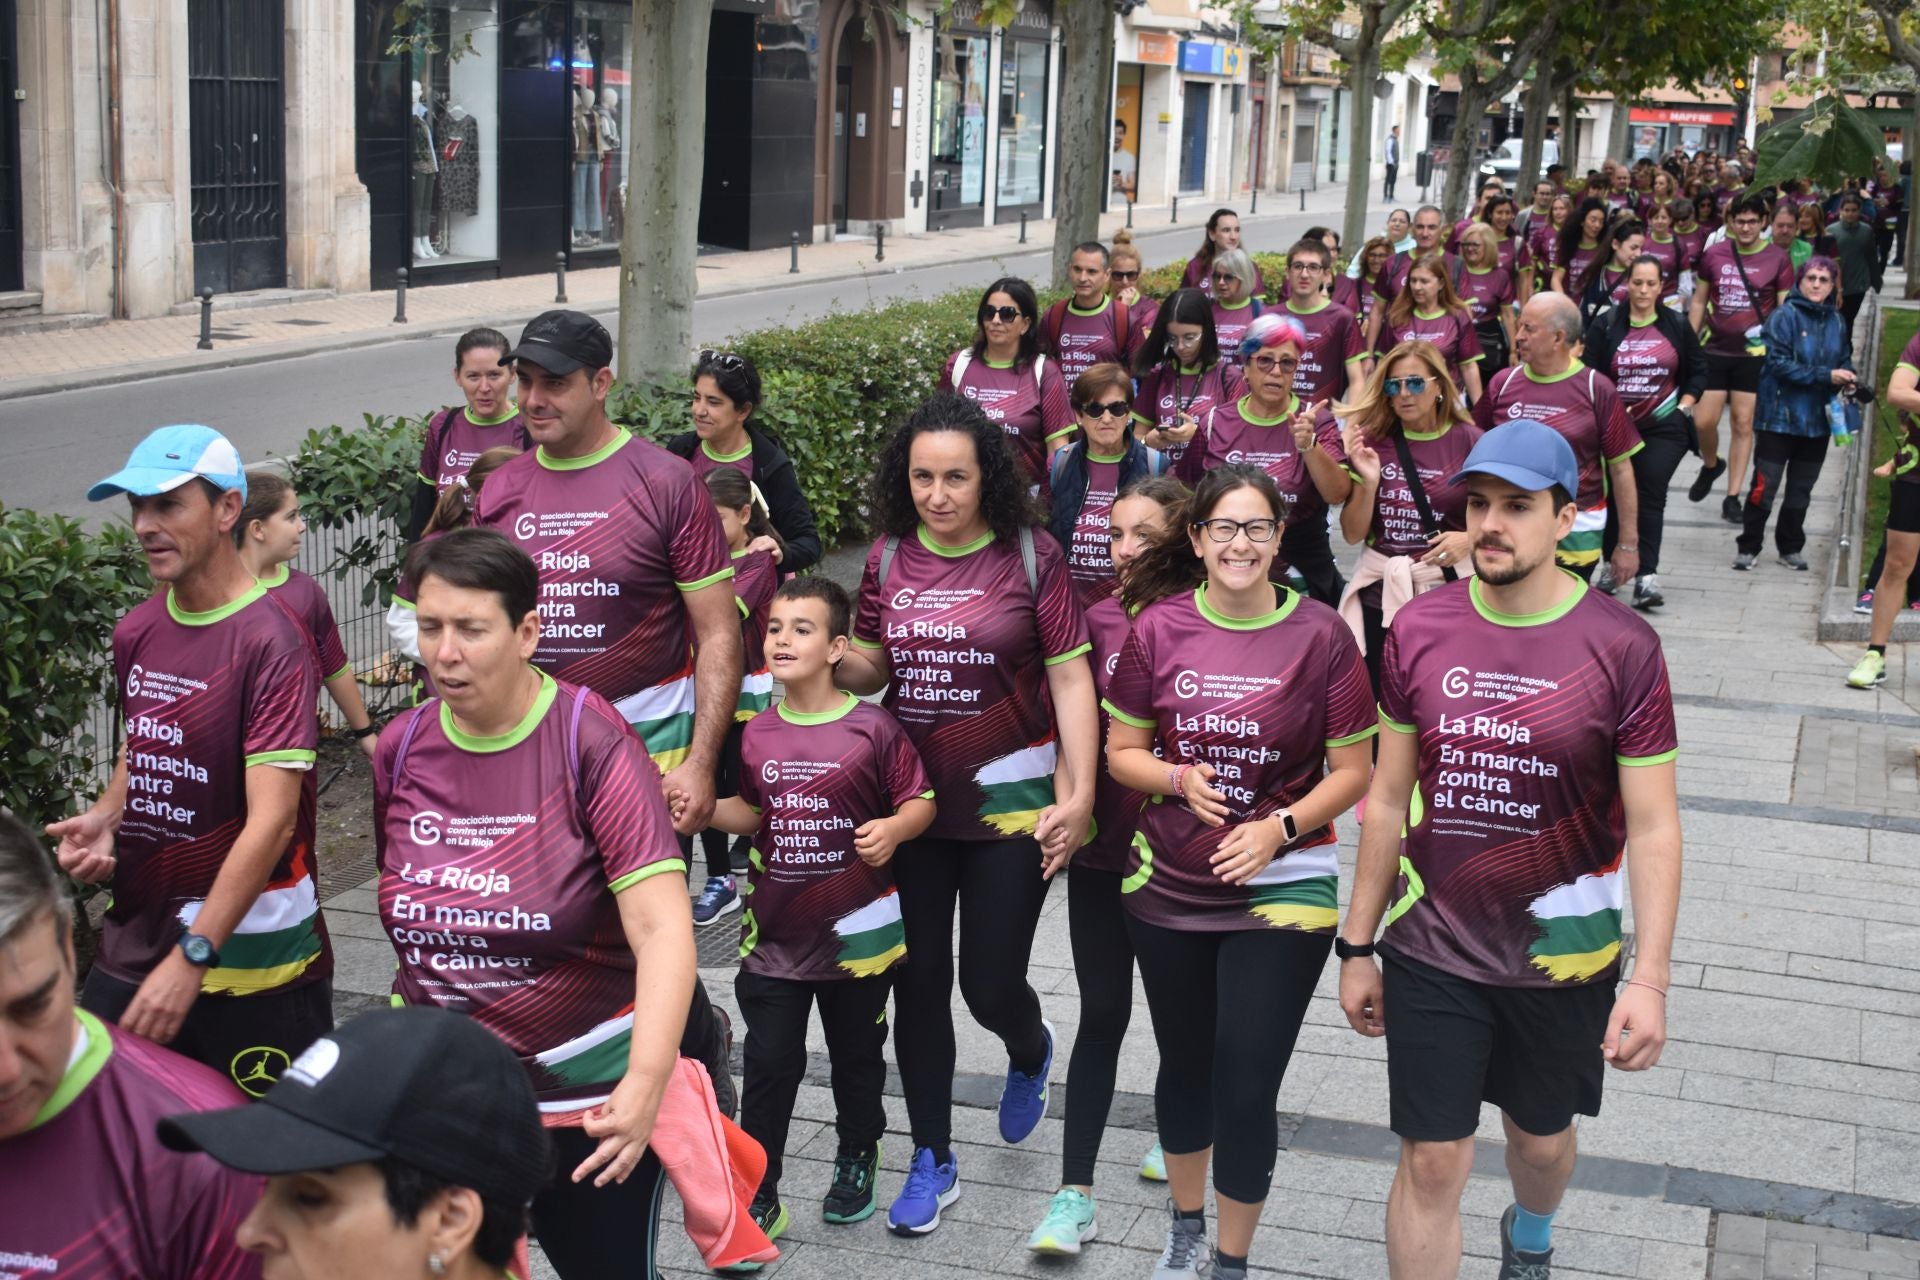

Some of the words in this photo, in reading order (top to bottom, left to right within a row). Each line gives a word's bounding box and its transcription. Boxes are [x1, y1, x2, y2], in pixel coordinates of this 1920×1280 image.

[1670, 112, 1712, 122] MAPFRE
[1061, 352, 1070, 360] La
[1073, 352, 1095, 361] Rioja
[1618, 356, 1630, 364] La
[1632, 355, 1657, 365] Rioja
[1632, 367, 1669, 375] marcha
[1161, 415, 1172, 424] La
[439, 473, 452, 484] La
[1379, 487, 1395, 499] La
[541, 512, 575, 520] asociación
[1380, 504, 1394, 515] En
[1086, 515, 1110, 528] Rioj
[1384, 519, 1419, 530] ontra
[559, 529, 575, 537] Rioja
[1072, 544, 1106, 554] ontra
[542, 550, 590, 572] Rioja
[543, 578, 619, 596] marcha
[537, 601, 575, 617] ntra
[538, 621, 605, 638] cáncer
[887, 623, 908, 638] La
[914, 621, 966, 642] Rioja
[891, 647, 913, 663] En
[917, 649, 995, 664] marcha
[146, 671, 177, 683] asociación
[179, 677, 208, 690] española
[896, 666, 952, 682] contra
[1204, 674, 1244, 683] asociación
[1246, 677, 1281, 685] española
[1476, 672, 1518, 682] asociación
[1520, 676, 1558, 689] española
[143, 680, 162, 690] contra
[163, 684, 171, 692] el
[899, 682, 910, 698] el
[914, 685, 981, 701] cáncer
[1238, 683, 1264, 692] cáncer
[1474, 681, 1501, 689] contra
[1502, 683, 1510, 691] el
[1512, 684, 1540, 695] cáncer
[158, 692, 176, 702] Rioja
[1224, 692, 1244, 700] Rioja
[1485, 690, 1495, 698] La
[1497, 692, 1517, 701] Rioja
[138, 717, 183, 745] Rioja
[1176, 713, 1199, 731] La
[1205, 714, 1260, 738] Rioja
[1439, 714, 1466, 734] La
[1474, 716, 1530, 745] Rioja
[1178, 741, 1203, 757] En
[1208, 745, 1281, 764] marcha
[1440, 744, 1464, 764] En
[1472, 751, 1558, 777] marcha
[1439, 770, 1510, 793] contra
[786, 794, 829, 811] Rioja
[1434, 790, 1455, 808] el
[1461, 793, 1540, 819] cáncer
[451, 816, 494, 825] asociación
[496, 814, 536, 824] española
[788, 816, 853, 830] marcha
[1465, 820, 1492, 828] ESPAÑOLA
[447, 827, 477, 836] contra
[479, 827, 486, 835] el
[488, 826, 516, 835] cáncer
[459, 837, 469, 846] La
[472, 838, 493, 848] Rioja
[774, 834, 819, 847] ontra
[785, 849, 845, 864] cáncer
[401, 862, 432, 885] La
[440, 867, 510, 897] Rioja
[392, 894, 426, 920] En
[435, 906, 551, 930] marcha
[393, 927, 488, 948] contra
[431, 950, 532, 970] cáncer
[474, 981, 500, 989] CONTRA
